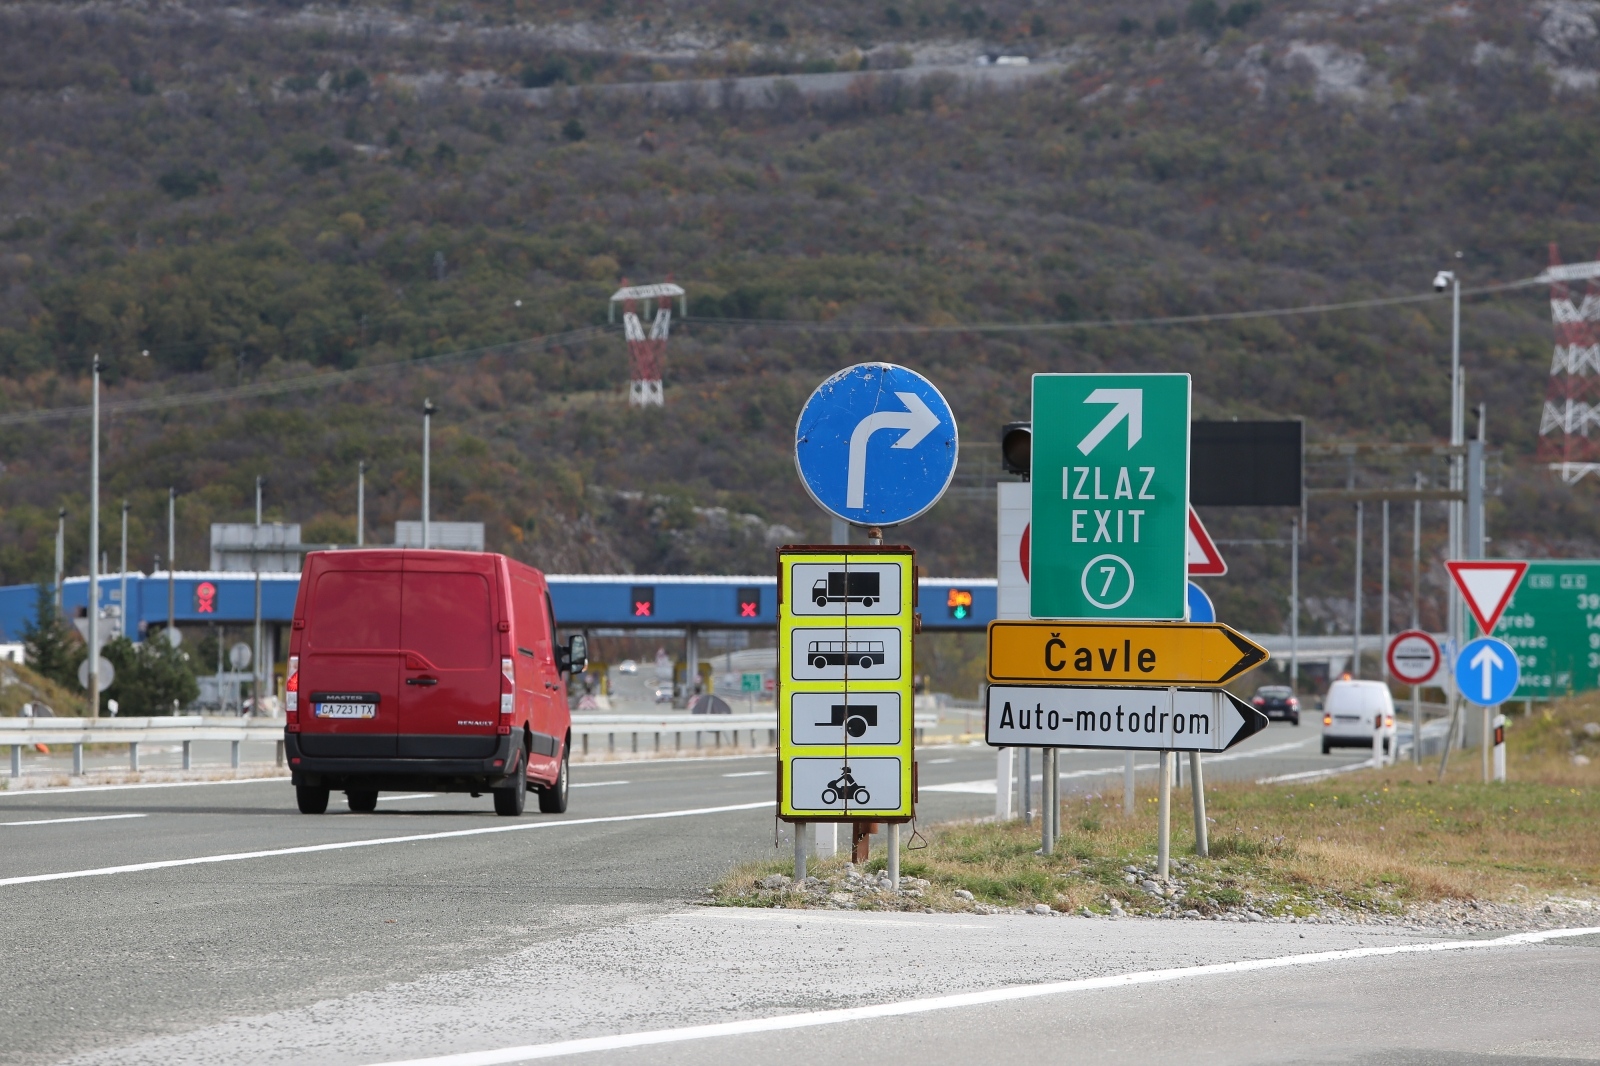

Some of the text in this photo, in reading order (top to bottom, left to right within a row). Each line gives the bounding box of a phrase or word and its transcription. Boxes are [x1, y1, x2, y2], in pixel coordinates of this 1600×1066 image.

[1062, 466, 1156, 500] IZLAZ
[1071, 509, 1145, 543] EXIT
[1099, 566, 1116, 597] 7
[1498, 612, 1536, 632] greb
[1044, 632, 1156, 673] Čavle
[999, 701, 1209, 735] Auto-motodrom
